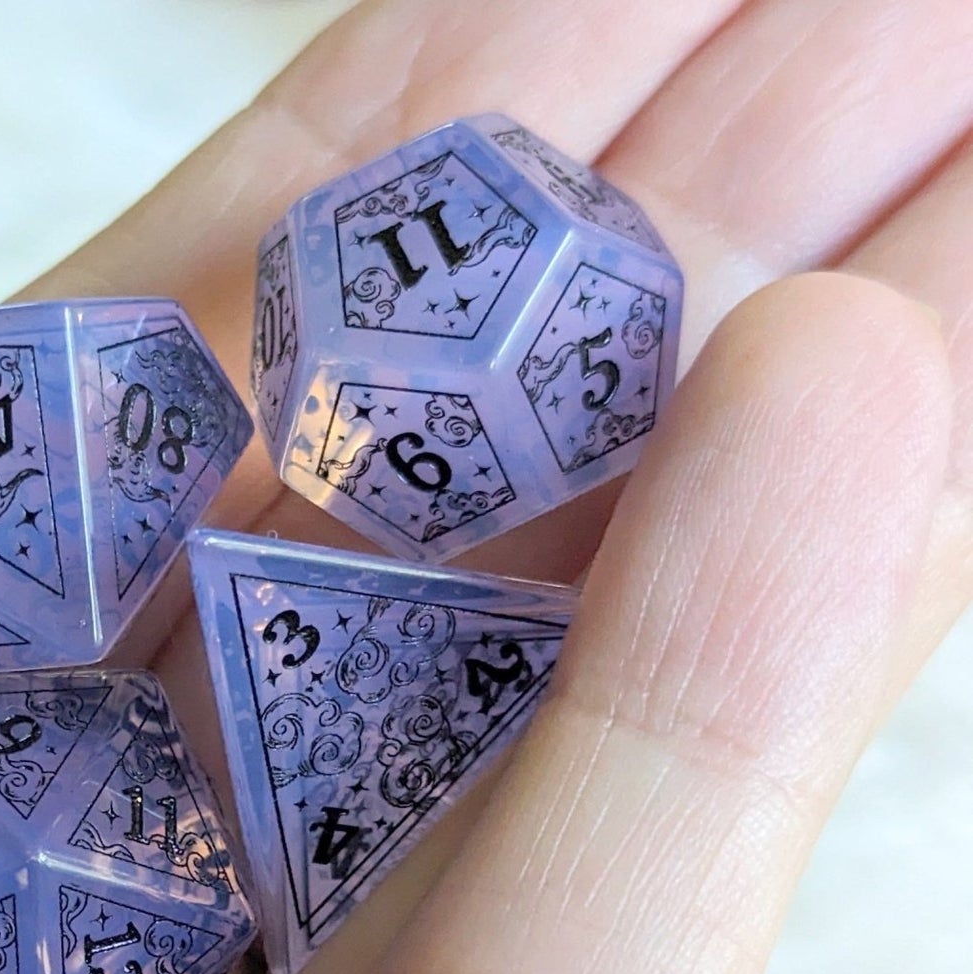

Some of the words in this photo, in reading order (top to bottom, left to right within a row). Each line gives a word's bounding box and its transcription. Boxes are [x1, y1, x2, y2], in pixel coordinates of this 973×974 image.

[368, 200, 472, 290] 11
[580, 327, 620, 411] 5
[118, 383, 195, 474] 80
[263, 609, 320, 668] 3
[465, 643, 523, 697] 2
[123, 785, 184, 855] 11
[309, 807, 360, 865] 4
